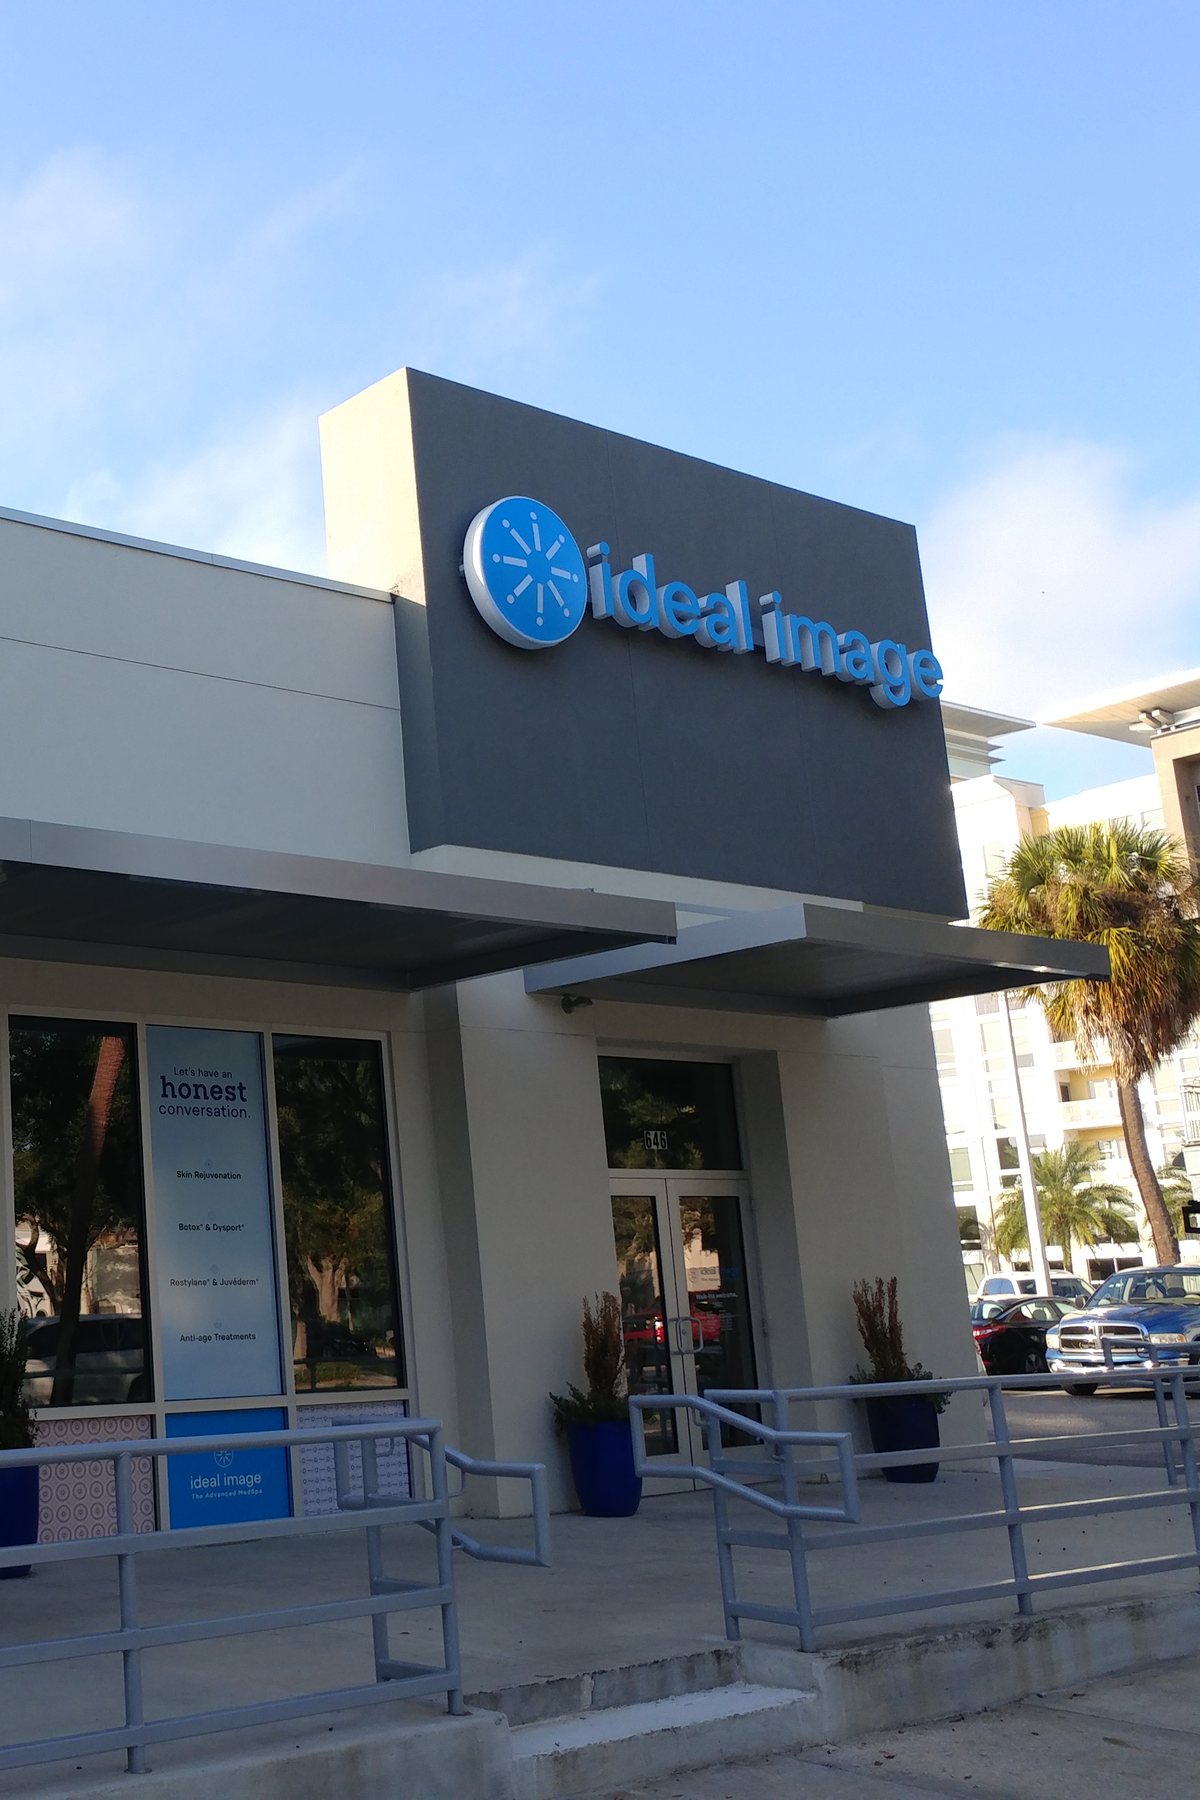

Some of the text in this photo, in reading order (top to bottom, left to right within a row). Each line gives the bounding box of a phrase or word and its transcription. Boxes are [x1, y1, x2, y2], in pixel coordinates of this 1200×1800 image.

[587, 541, 943, 709] ideal image
[173, 1066, 233, 1079] Let's have an
[160, 1075, 248, 1103] honest
[158, 1104, 252, 1119] conversation.
[645, 1131, 667, 1149] 646
[176, 1170, 242, 1180] Skin Rejuvenation
[205, 1223, 211, 1231] &
[179, 1333, 256, 1343] Anti-age Treatments
[190, 1473, 262, 1489] ideal image
